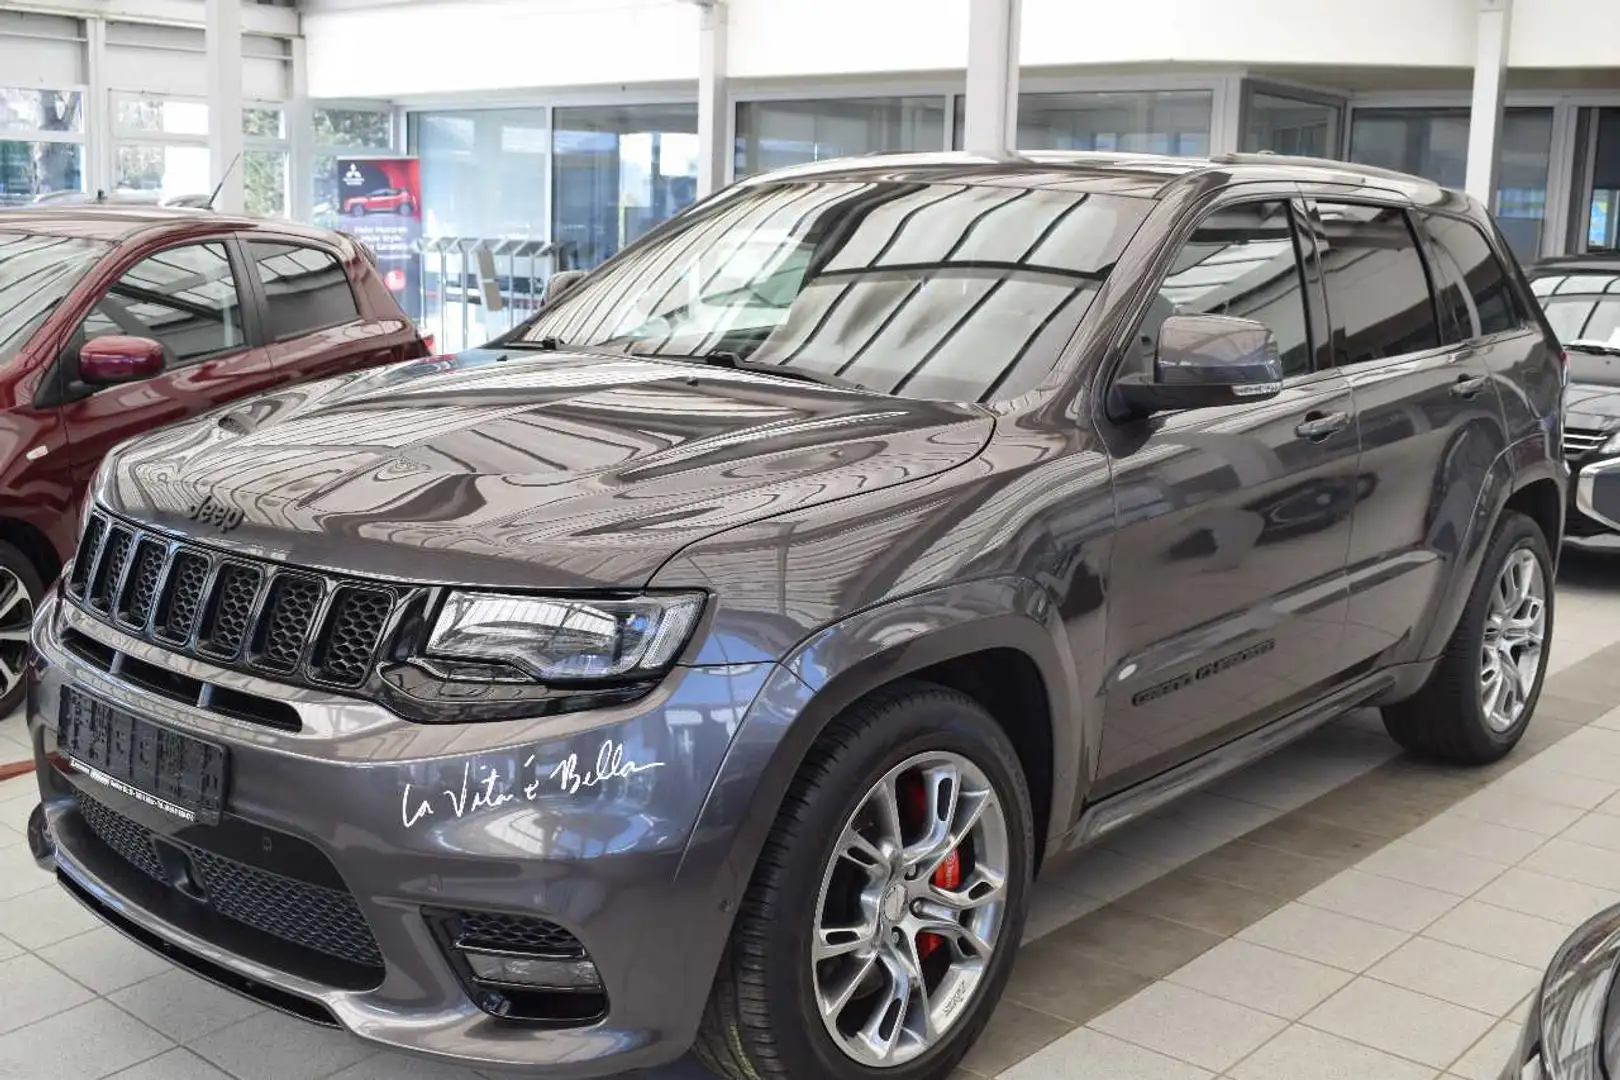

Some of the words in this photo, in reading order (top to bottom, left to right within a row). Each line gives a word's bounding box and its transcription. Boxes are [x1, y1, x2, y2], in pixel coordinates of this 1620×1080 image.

[189, 495, 246, 535] Jeep
[402, 784, 434, 828] La
[444, 761, 514, 818] Vita
[550, 739, 666, 794] Bella
